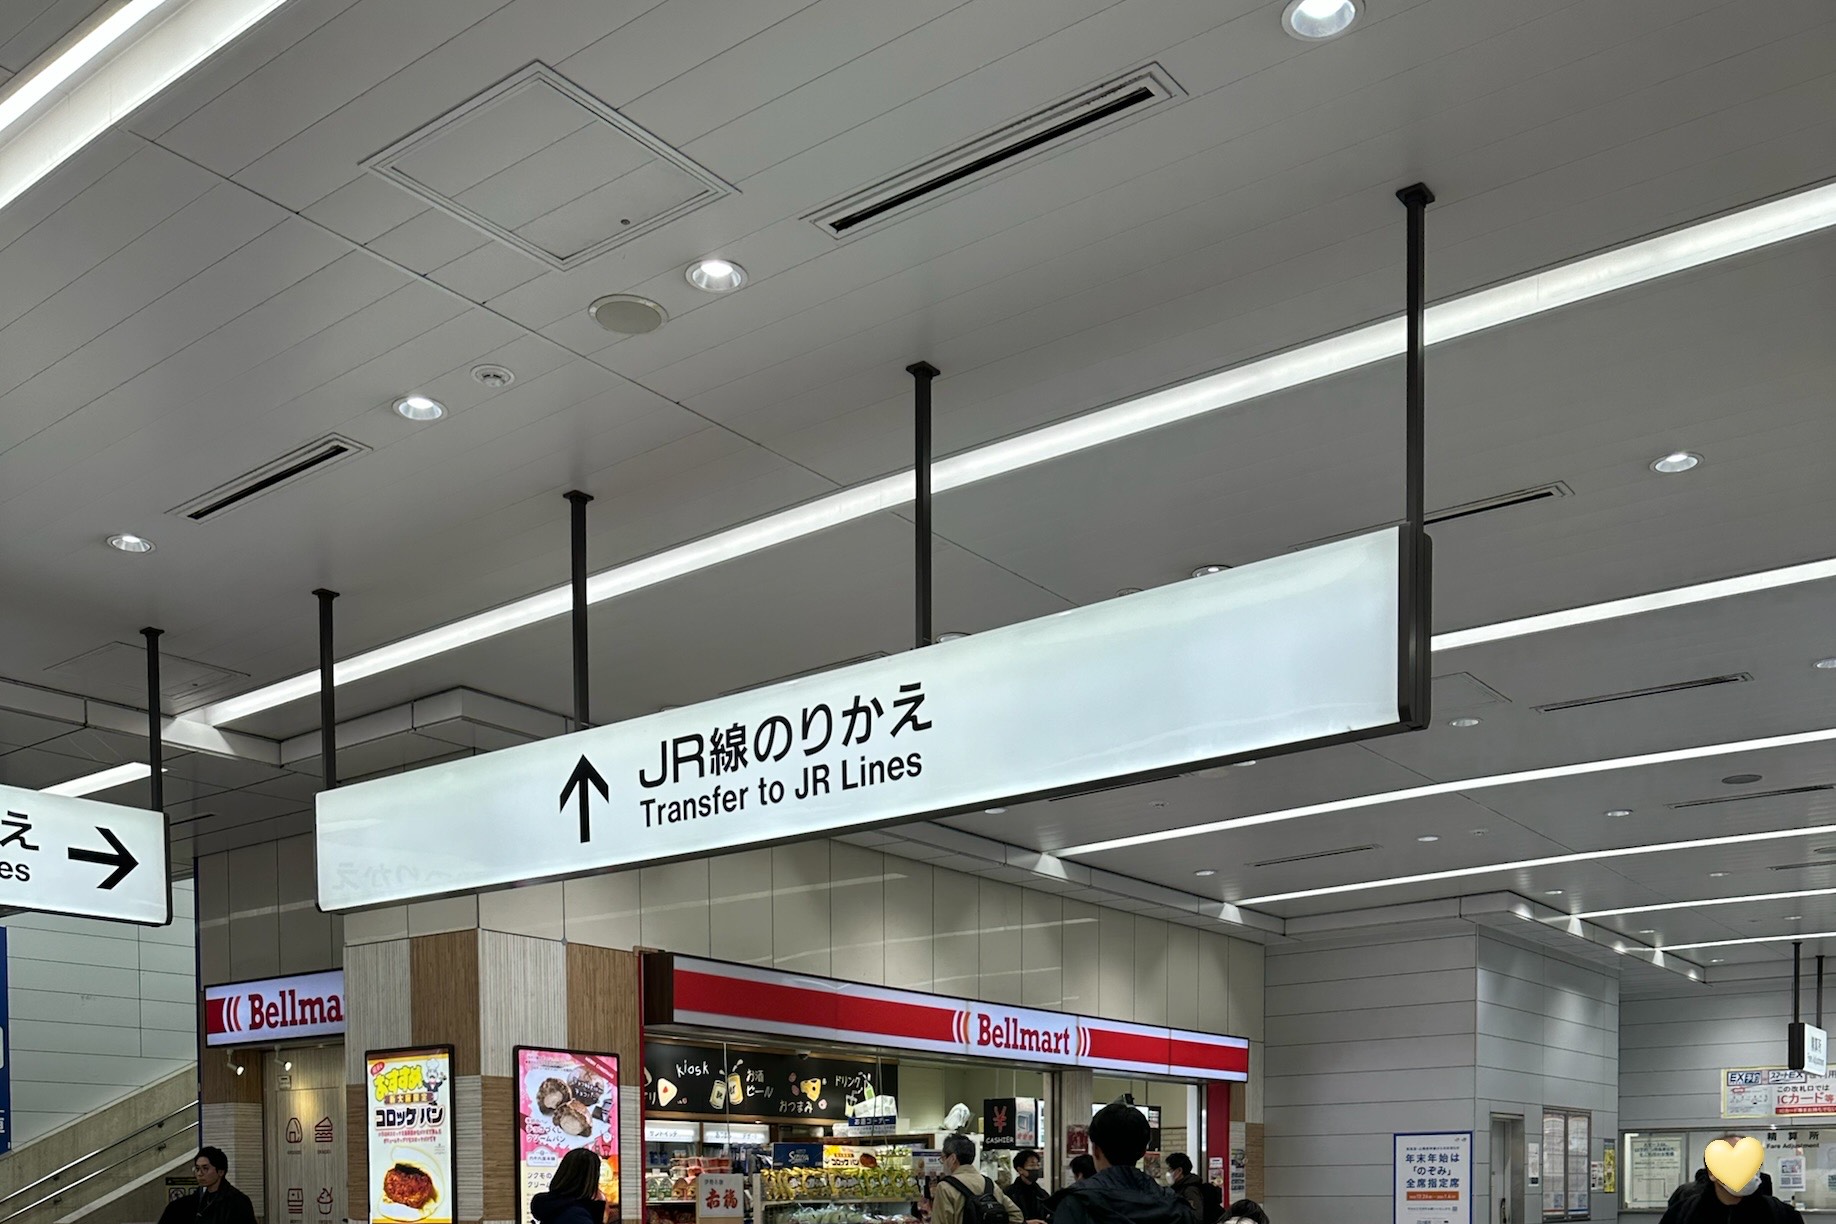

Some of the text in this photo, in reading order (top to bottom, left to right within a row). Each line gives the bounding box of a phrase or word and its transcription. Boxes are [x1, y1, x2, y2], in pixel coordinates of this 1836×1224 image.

[639, 682, 932, 789] JR線のりかえ
[640, 752, 922, 828] Transfer to JR Lines
[248, 989, 343, 1030] Bellma
[977, 1013, 1070, 1056] Bellmart
[676, 1060, 709, 1077] kiosk
[746, 1069, 764, 1082] お酒
[835, 1075, 861, 1088] ドリンク
[373, 1065, 423, 1102] おすすめ
[1777, 1085, 1830, 1093] この改札口では
[747, 1086, 774, 1098] ビール
[779, 1101, 813, 1114] おつまみ
[986, 1136, 1014, 1144] CASHIER
[1767, 1131, 1820, 1140] 精算所
[1406, 1153, 1460, 1163] 年末年始は
[1413, 1166, 1451, 1176] 「のぞみ」
[1406, 1178, 1460, 1188] 全席指定席
[705, 1188, 738, 1210] 赤福
